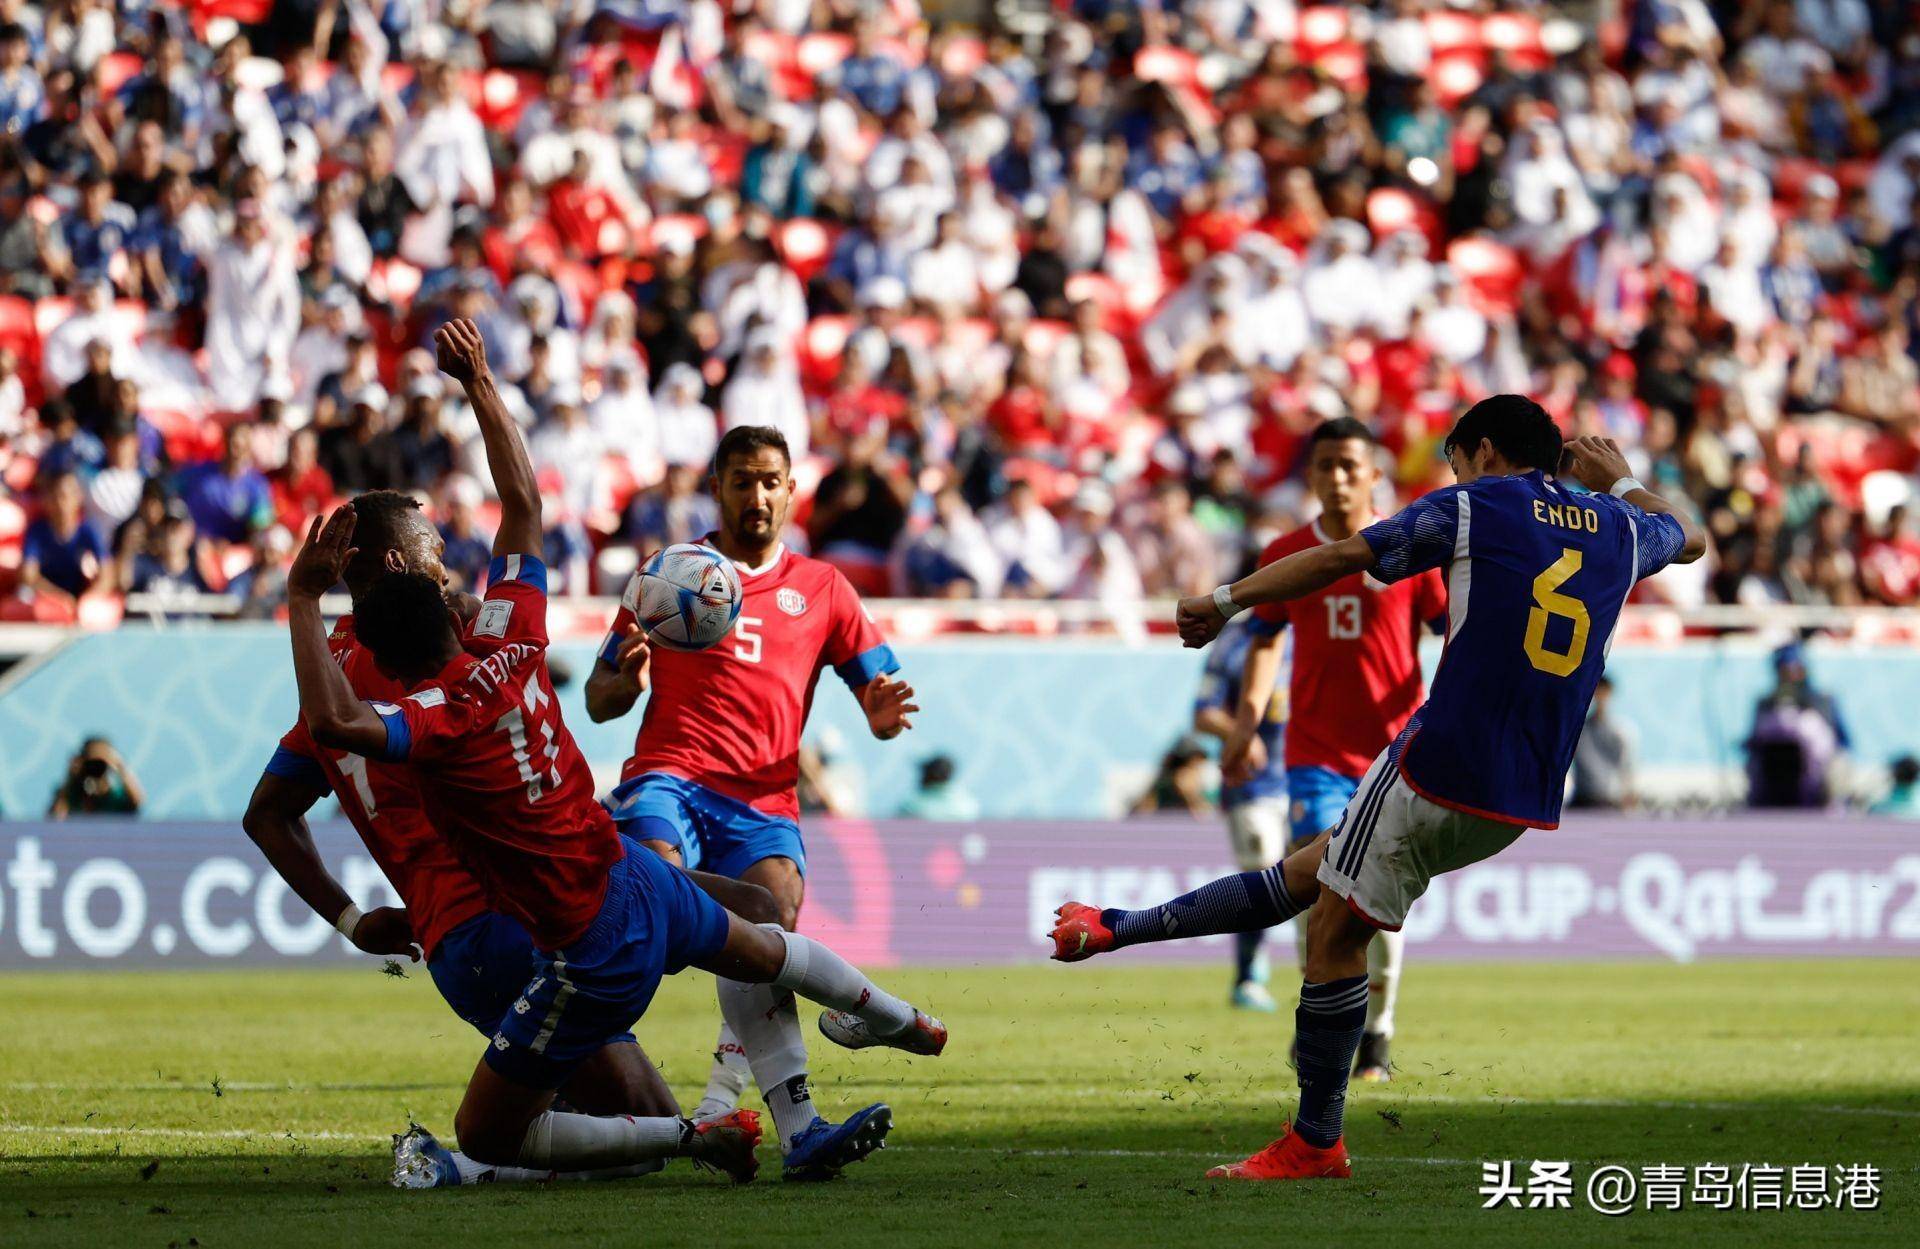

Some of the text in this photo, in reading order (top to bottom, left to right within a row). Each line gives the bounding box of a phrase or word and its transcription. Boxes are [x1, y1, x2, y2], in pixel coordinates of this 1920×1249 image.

[1532, 499, 1598, 534] ENDO
[1323, 595, 1361, 640] 13
[1523, 547, 1591, 678] 6
[735, 616, 763, 664] 5
[0, 836, 405, 957] to.co
